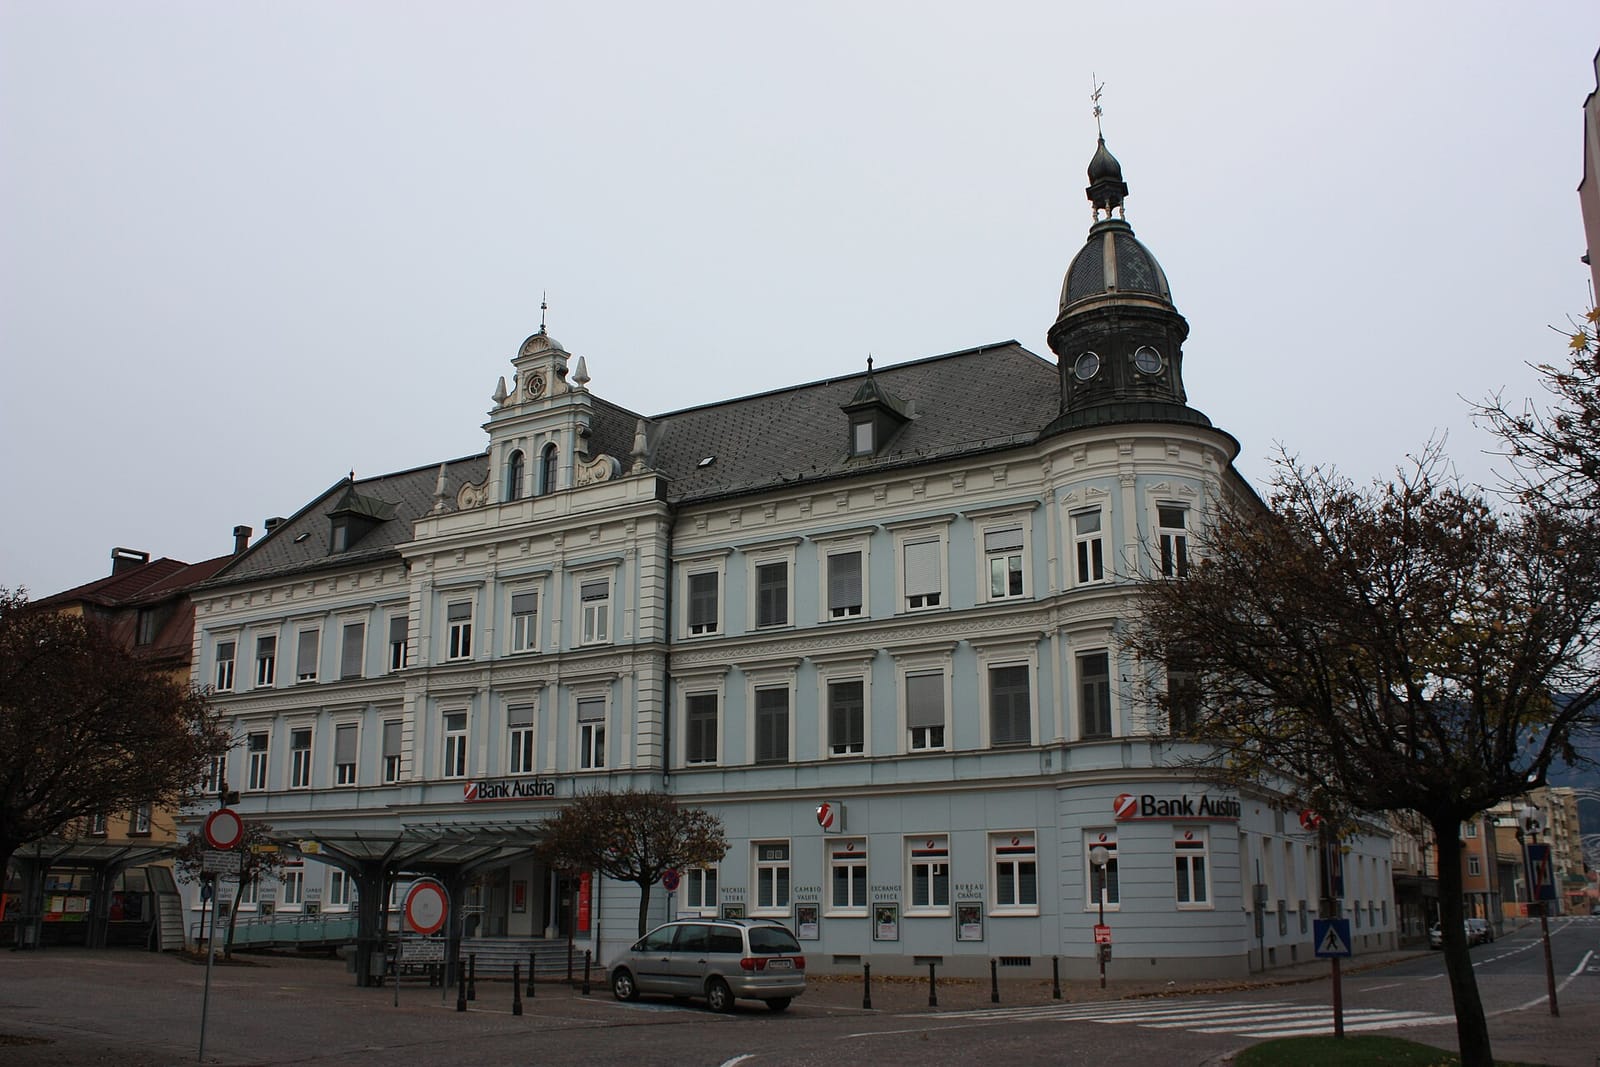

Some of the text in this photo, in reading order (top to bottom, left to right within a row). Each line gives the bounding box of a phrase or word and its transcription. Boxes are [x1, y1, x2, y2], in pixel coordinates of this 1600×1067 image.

[479, 778, 554, 798] Bank Austria
[1141, 794, 1241, 817] Bank Austria
